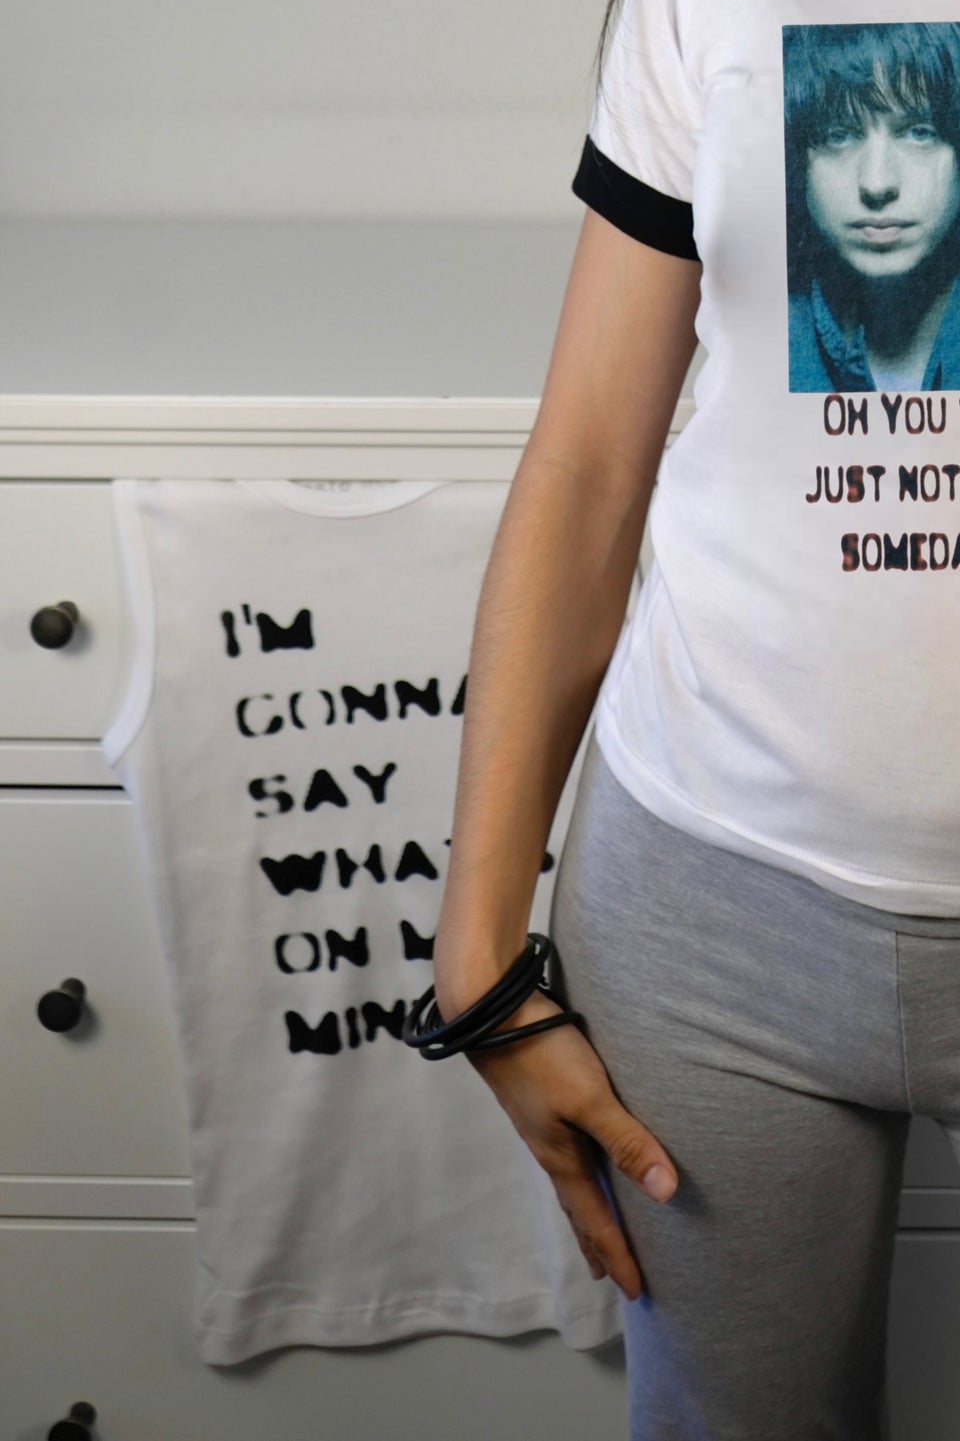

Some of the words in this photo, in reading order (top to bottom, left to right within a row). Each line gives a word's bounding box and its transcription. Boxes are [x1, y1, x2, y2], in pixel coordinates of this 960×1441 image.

[823, 393, 869, 437] OH
[880, 393, 947, 435] YOU
[805, 463, 886, 504] JUST
[221, 603, 316, 658] I'M
[248, 762, 399, 819] SAY
[274, 926, 370, 975] ON
[284, 997, 421, 1056] MIN
